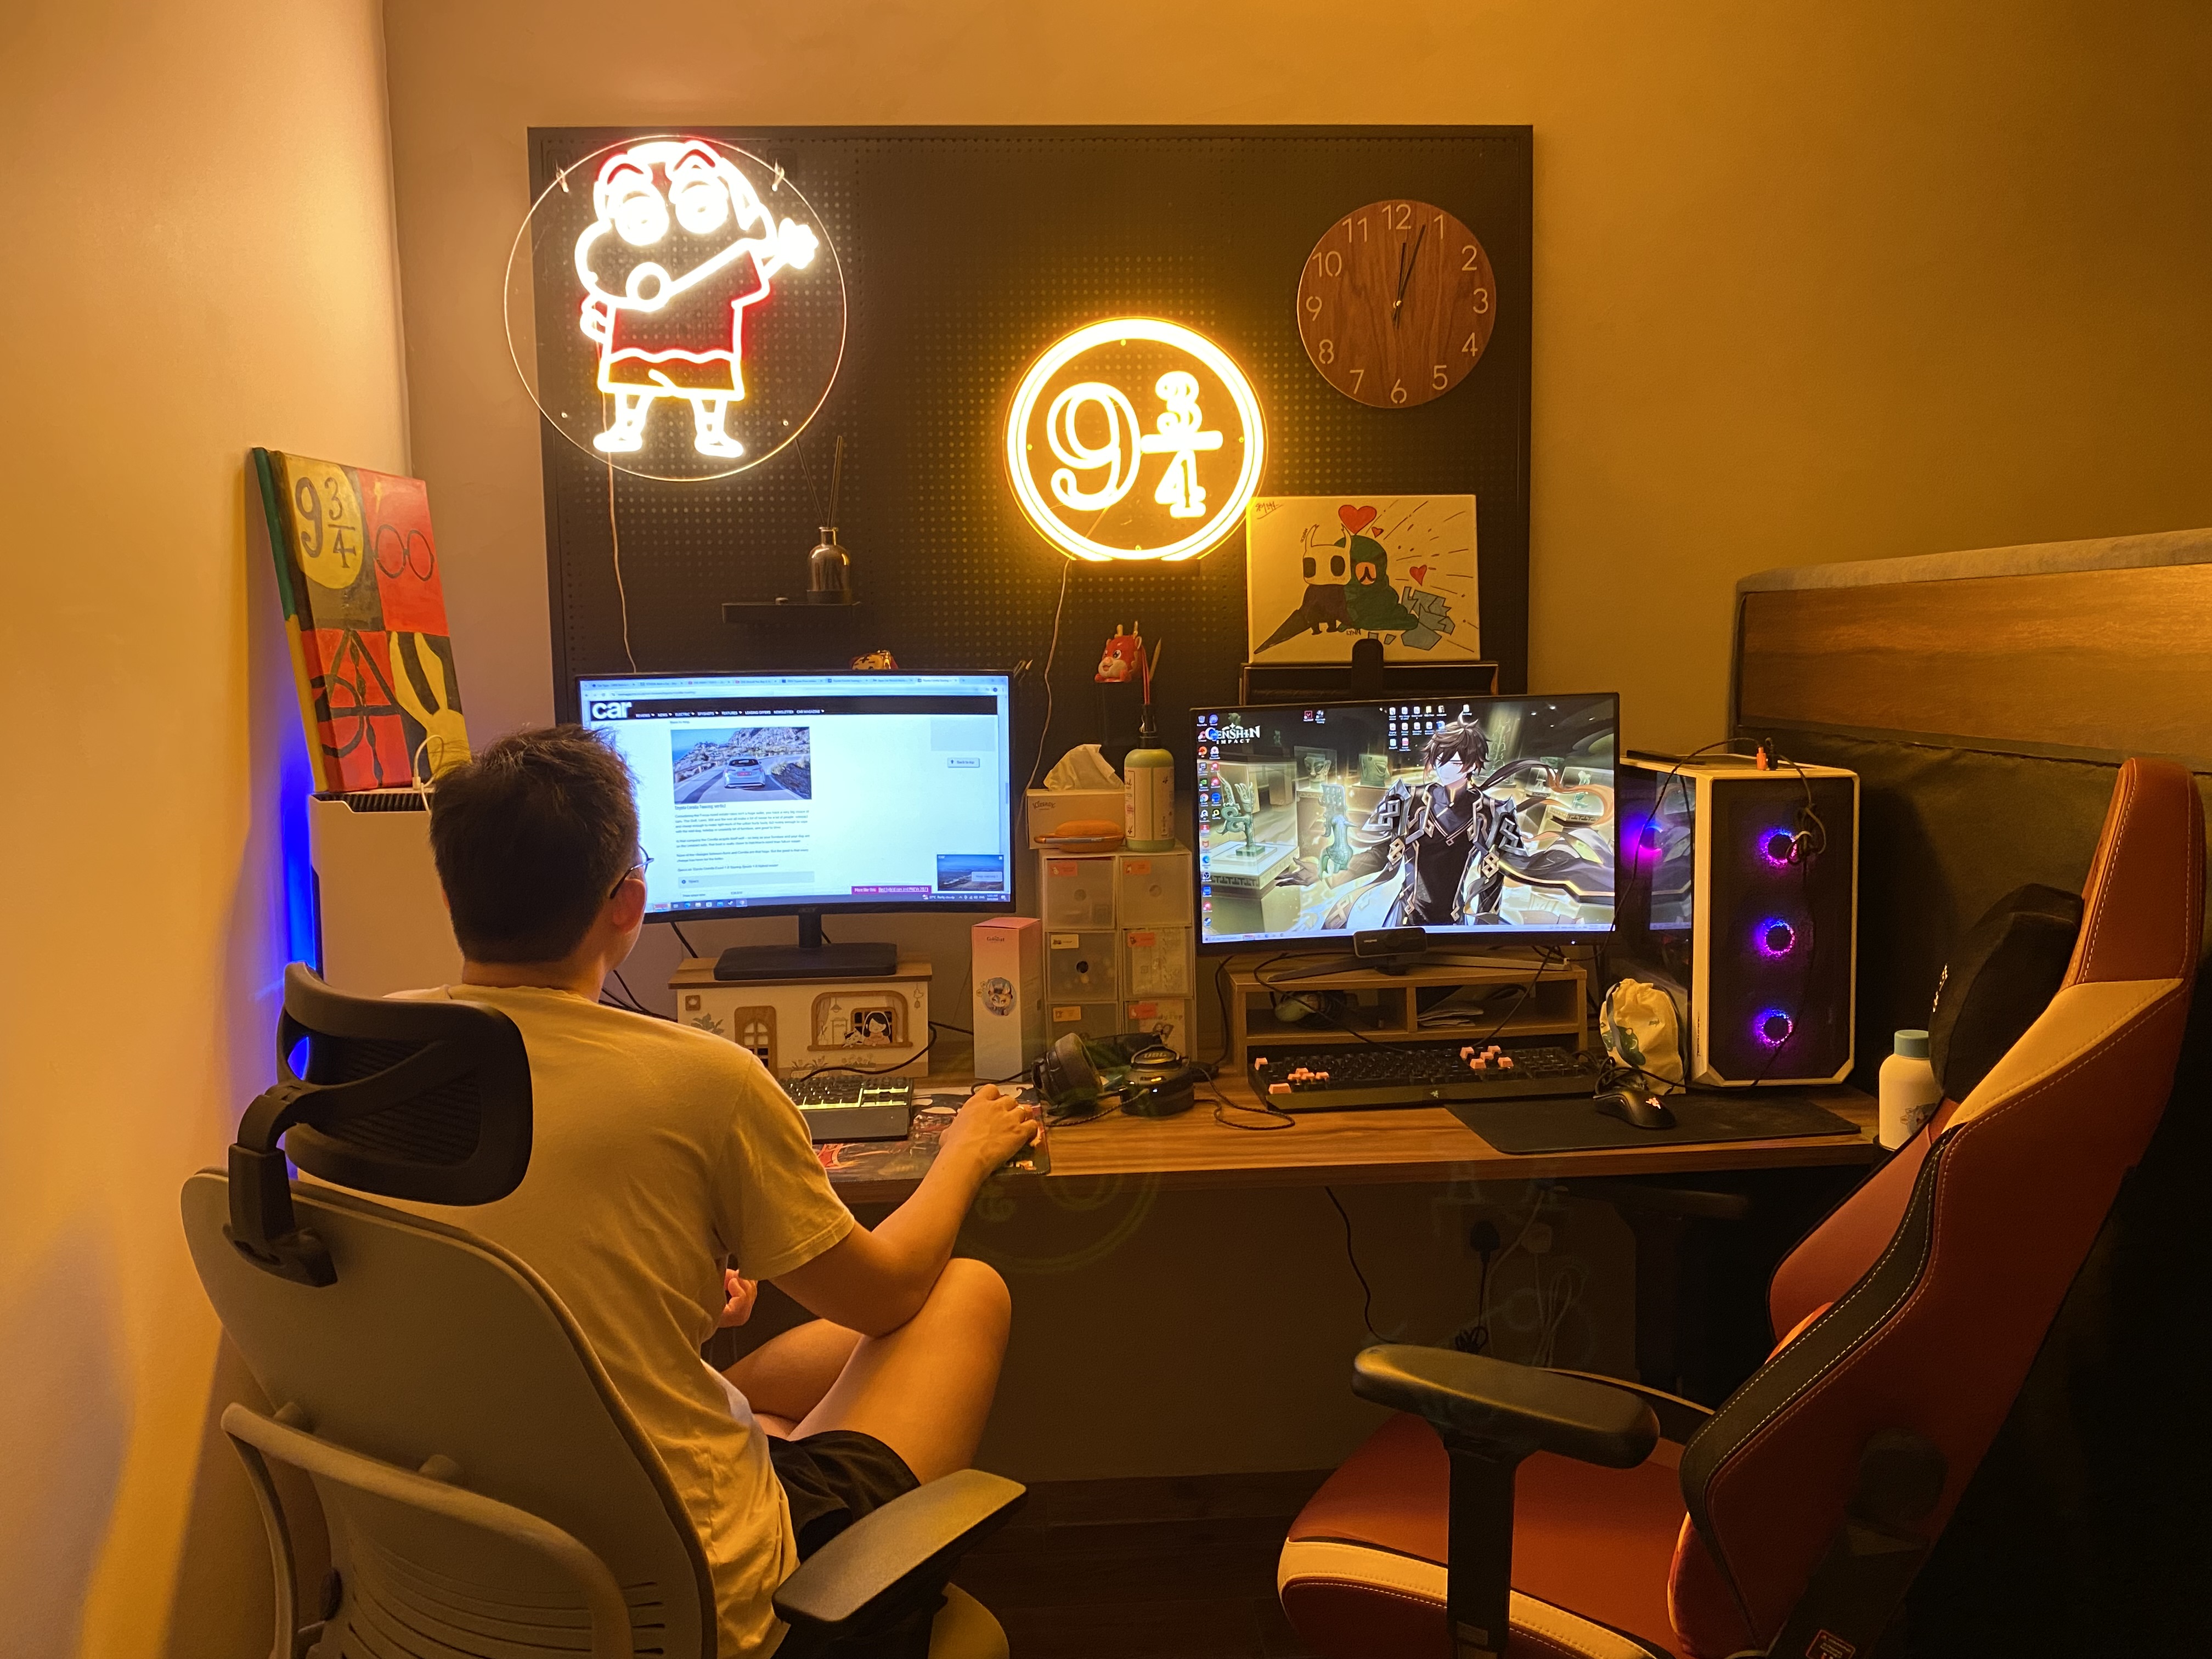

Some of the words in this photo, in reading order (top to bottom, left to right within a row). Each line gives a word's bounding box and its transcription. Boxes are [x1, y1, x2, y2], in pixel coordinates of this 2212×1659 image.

[1342, 217, 1368, 243] 11
[1381, 204, 1412, 230] 12
[1434, 214, 1443, 240] 1
[1312, 251, 1342, 278] 10
[1462, 245, 1477, 271] 2
[1306, 296, 1322, 321] 9
[1472, 288, 1488, 314] 3
[1318, 339, 1334, 364] 8
[1462, 332, 1478, 357] 4
[1350, 369, 1364, 394] 7
[1432, 365, 1448, 391] 5
[1390, 379, 1407, 404] 6
[592, 701, 633, 720] car
